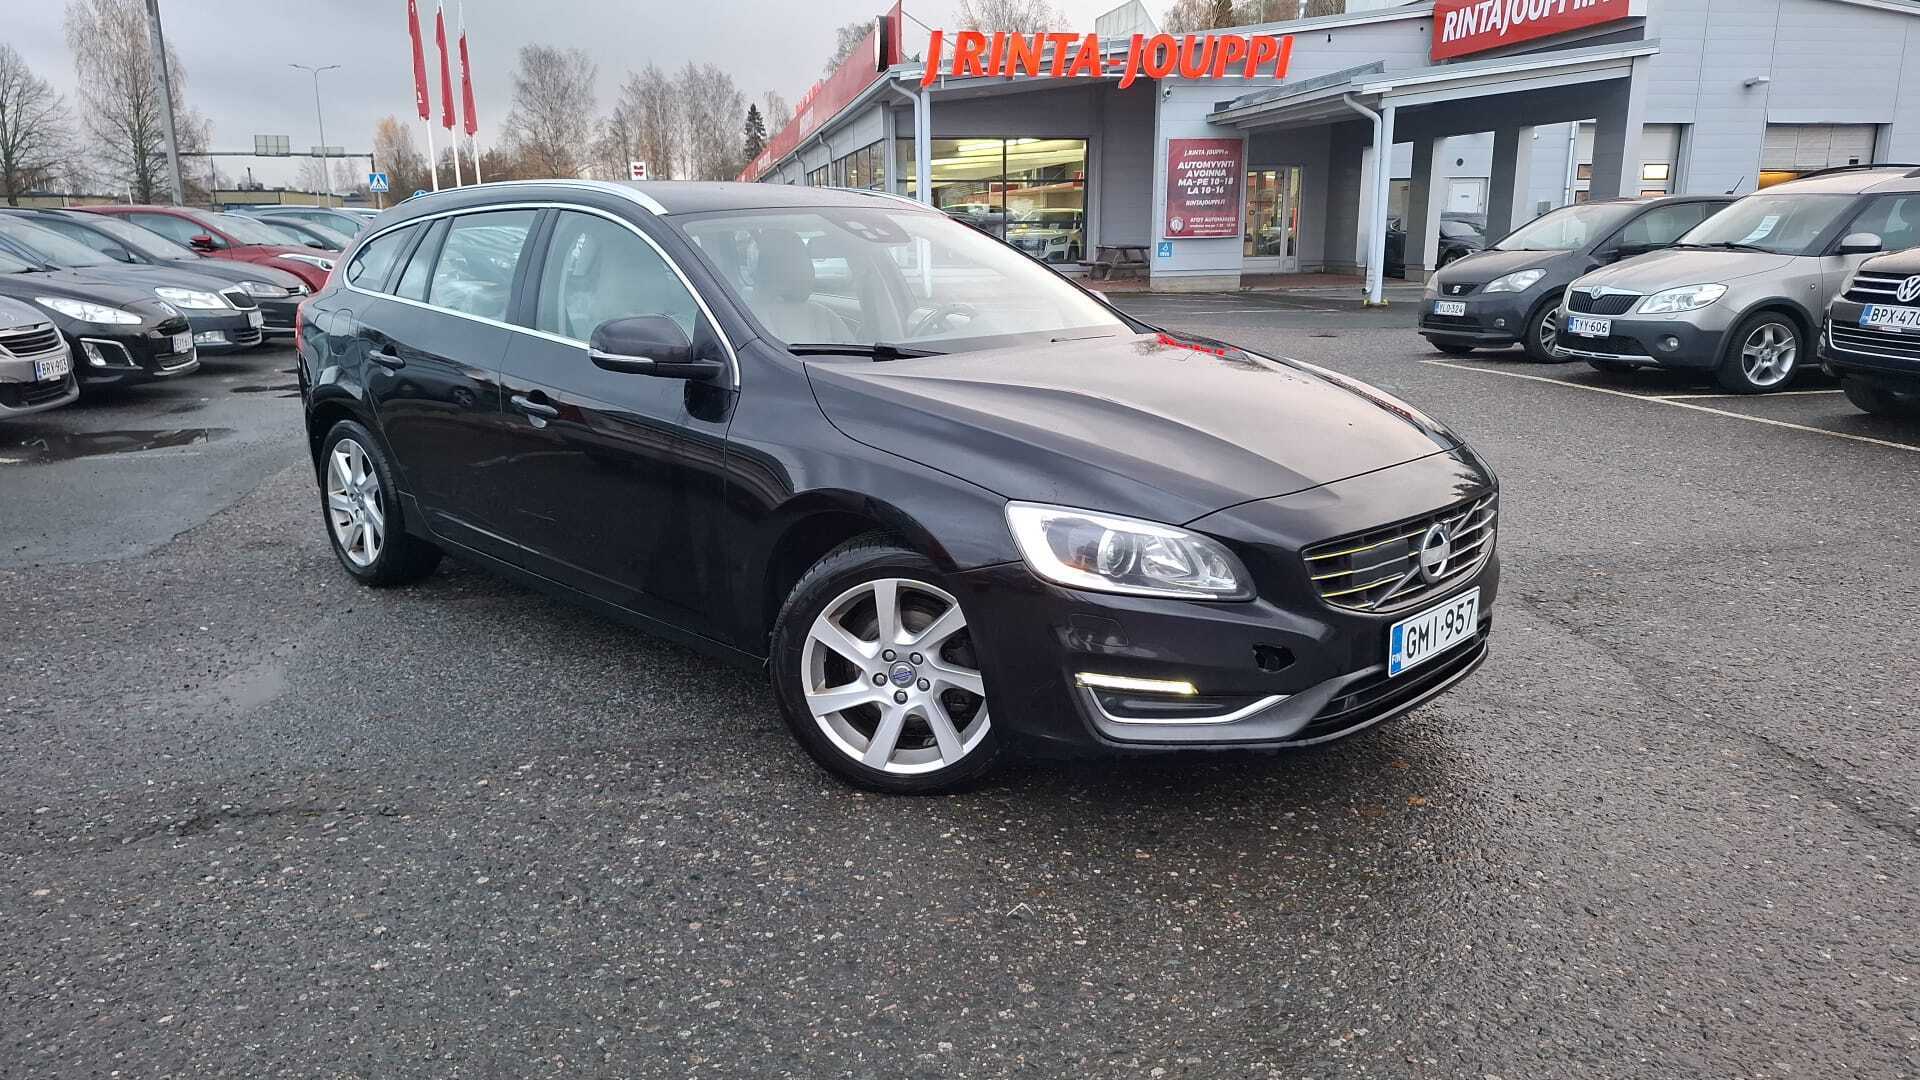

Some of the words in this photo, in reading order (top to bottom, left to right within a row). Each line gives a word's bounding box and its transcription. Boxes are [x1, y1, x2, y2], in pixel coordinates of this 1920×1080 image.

[1442, 0, 1608, 43] RINTAJOU.
[920, 30, 943, 88] J
[952, 31, 1296, 89] RINTA-JOUPPI
[1177, 160, 1235, 169] AUTOMYYNTI
[1186, 169, 1227, 178] AVOINNA
[1178, 178, 1209, 187] MA-PE
[1210, 177, 1234, 185] 10-18
[1187, 186, 1199, 195] LA
[1201, 186, 1224, 195] 10-16
[1575, 319, 1608, 333] TYY-606
[41, 358, 68, 376] BRY-903
[1406, 597, 1475, 660] GMI-957
